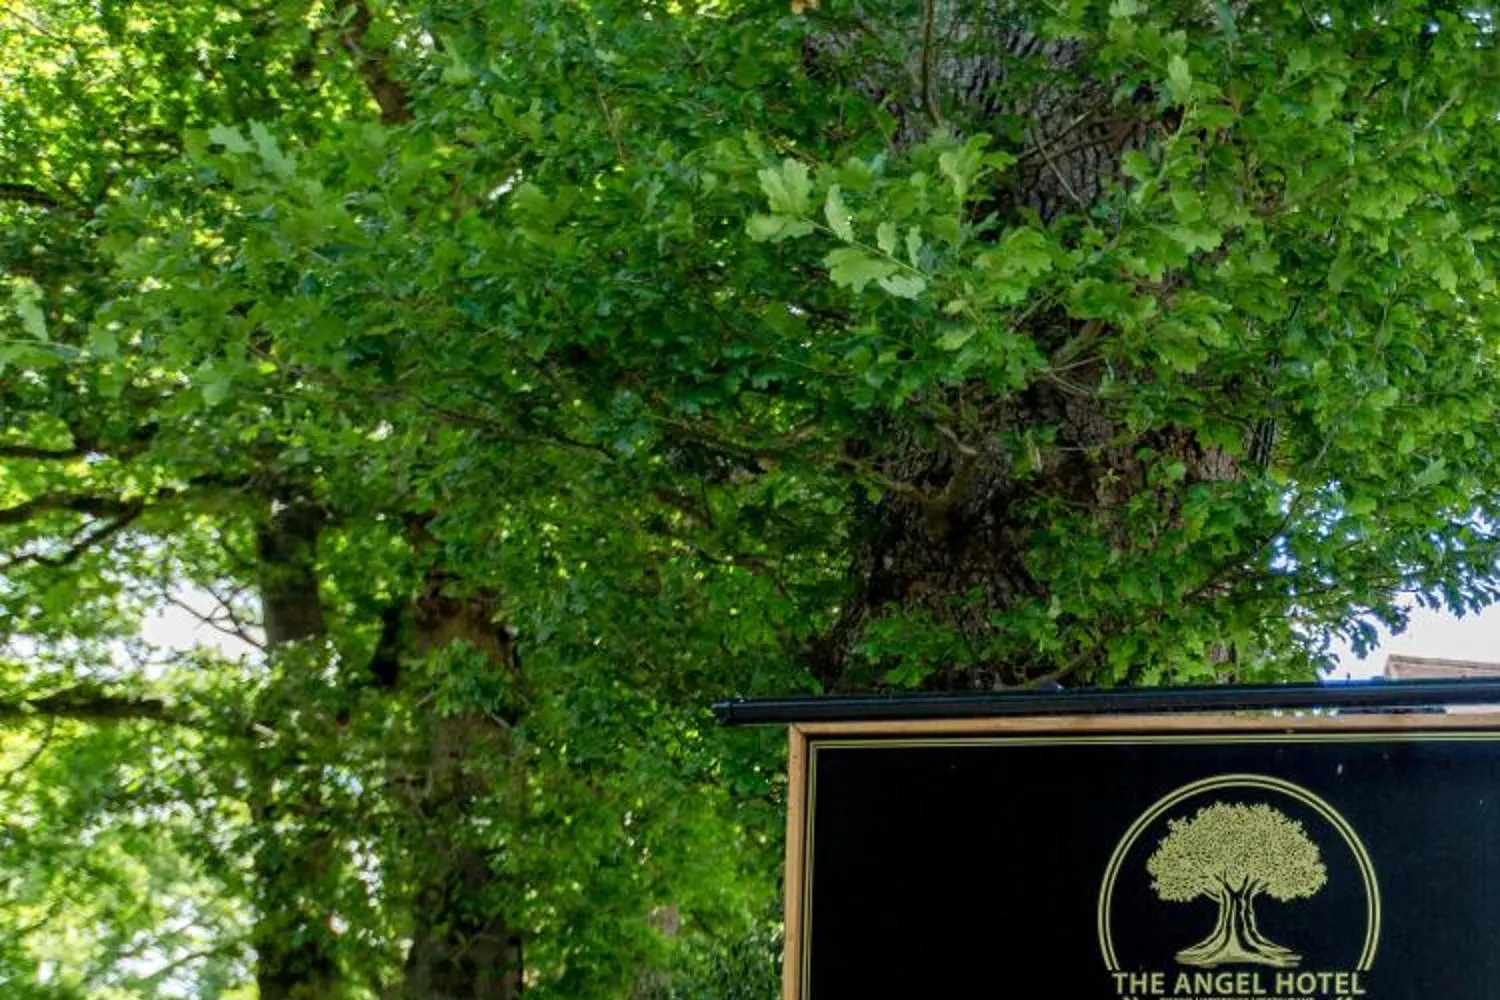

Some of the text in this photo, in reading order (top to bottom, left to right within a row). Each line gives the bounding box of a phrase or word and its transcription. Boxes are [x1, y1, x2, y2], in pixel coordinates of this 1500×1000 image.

[1112, 972, 1367, 995] THE ANGEL HOTEL
